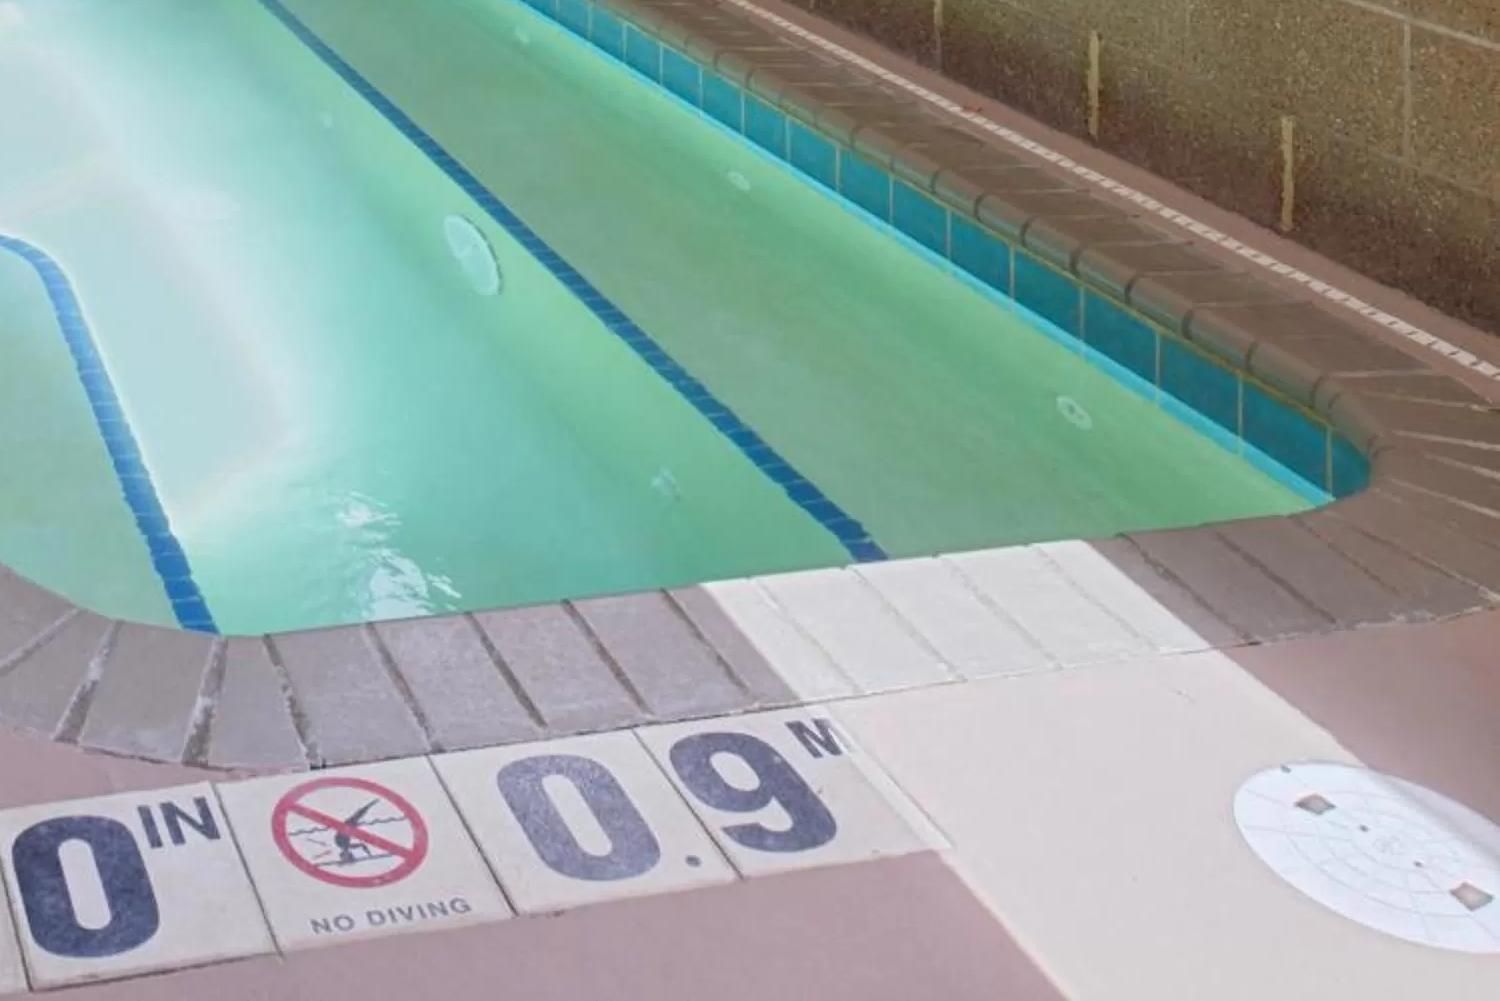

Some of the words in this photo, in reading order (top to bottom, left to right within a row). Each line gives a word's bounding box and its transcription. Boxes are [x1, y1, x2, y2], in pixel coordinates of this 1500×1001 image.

[136, 796, 221, 849] IN
[310, 914, 355, 934] NO
[365, 897, 472, 927] DIVING
